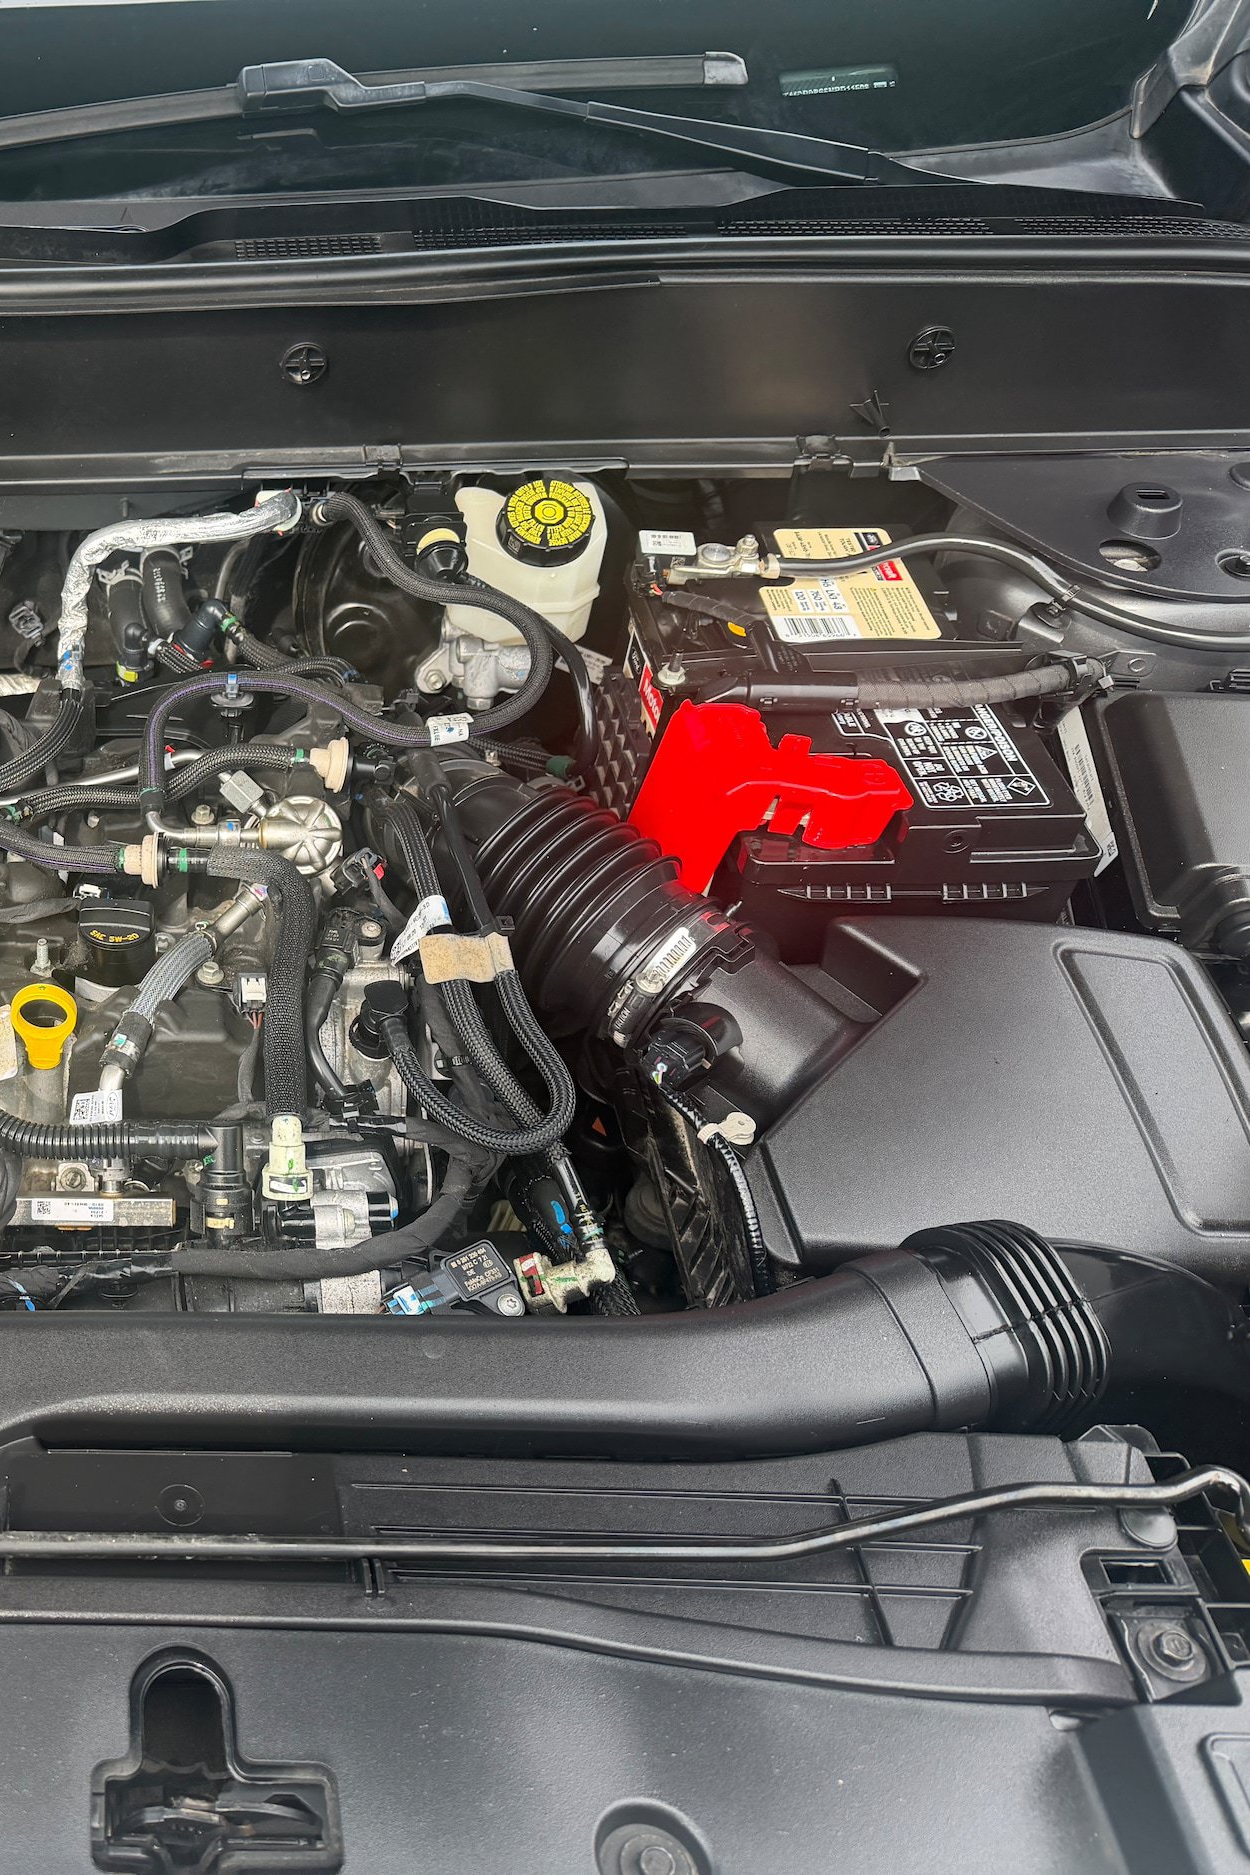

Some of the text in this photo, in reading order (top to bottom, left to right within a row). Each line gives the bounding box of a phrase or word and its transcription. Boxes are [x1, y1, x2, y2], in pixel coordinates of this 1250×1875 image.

[975, 703, 1019, 761] ANGER/POISON
[90, 929, 140, 943] SAE 5W-20
